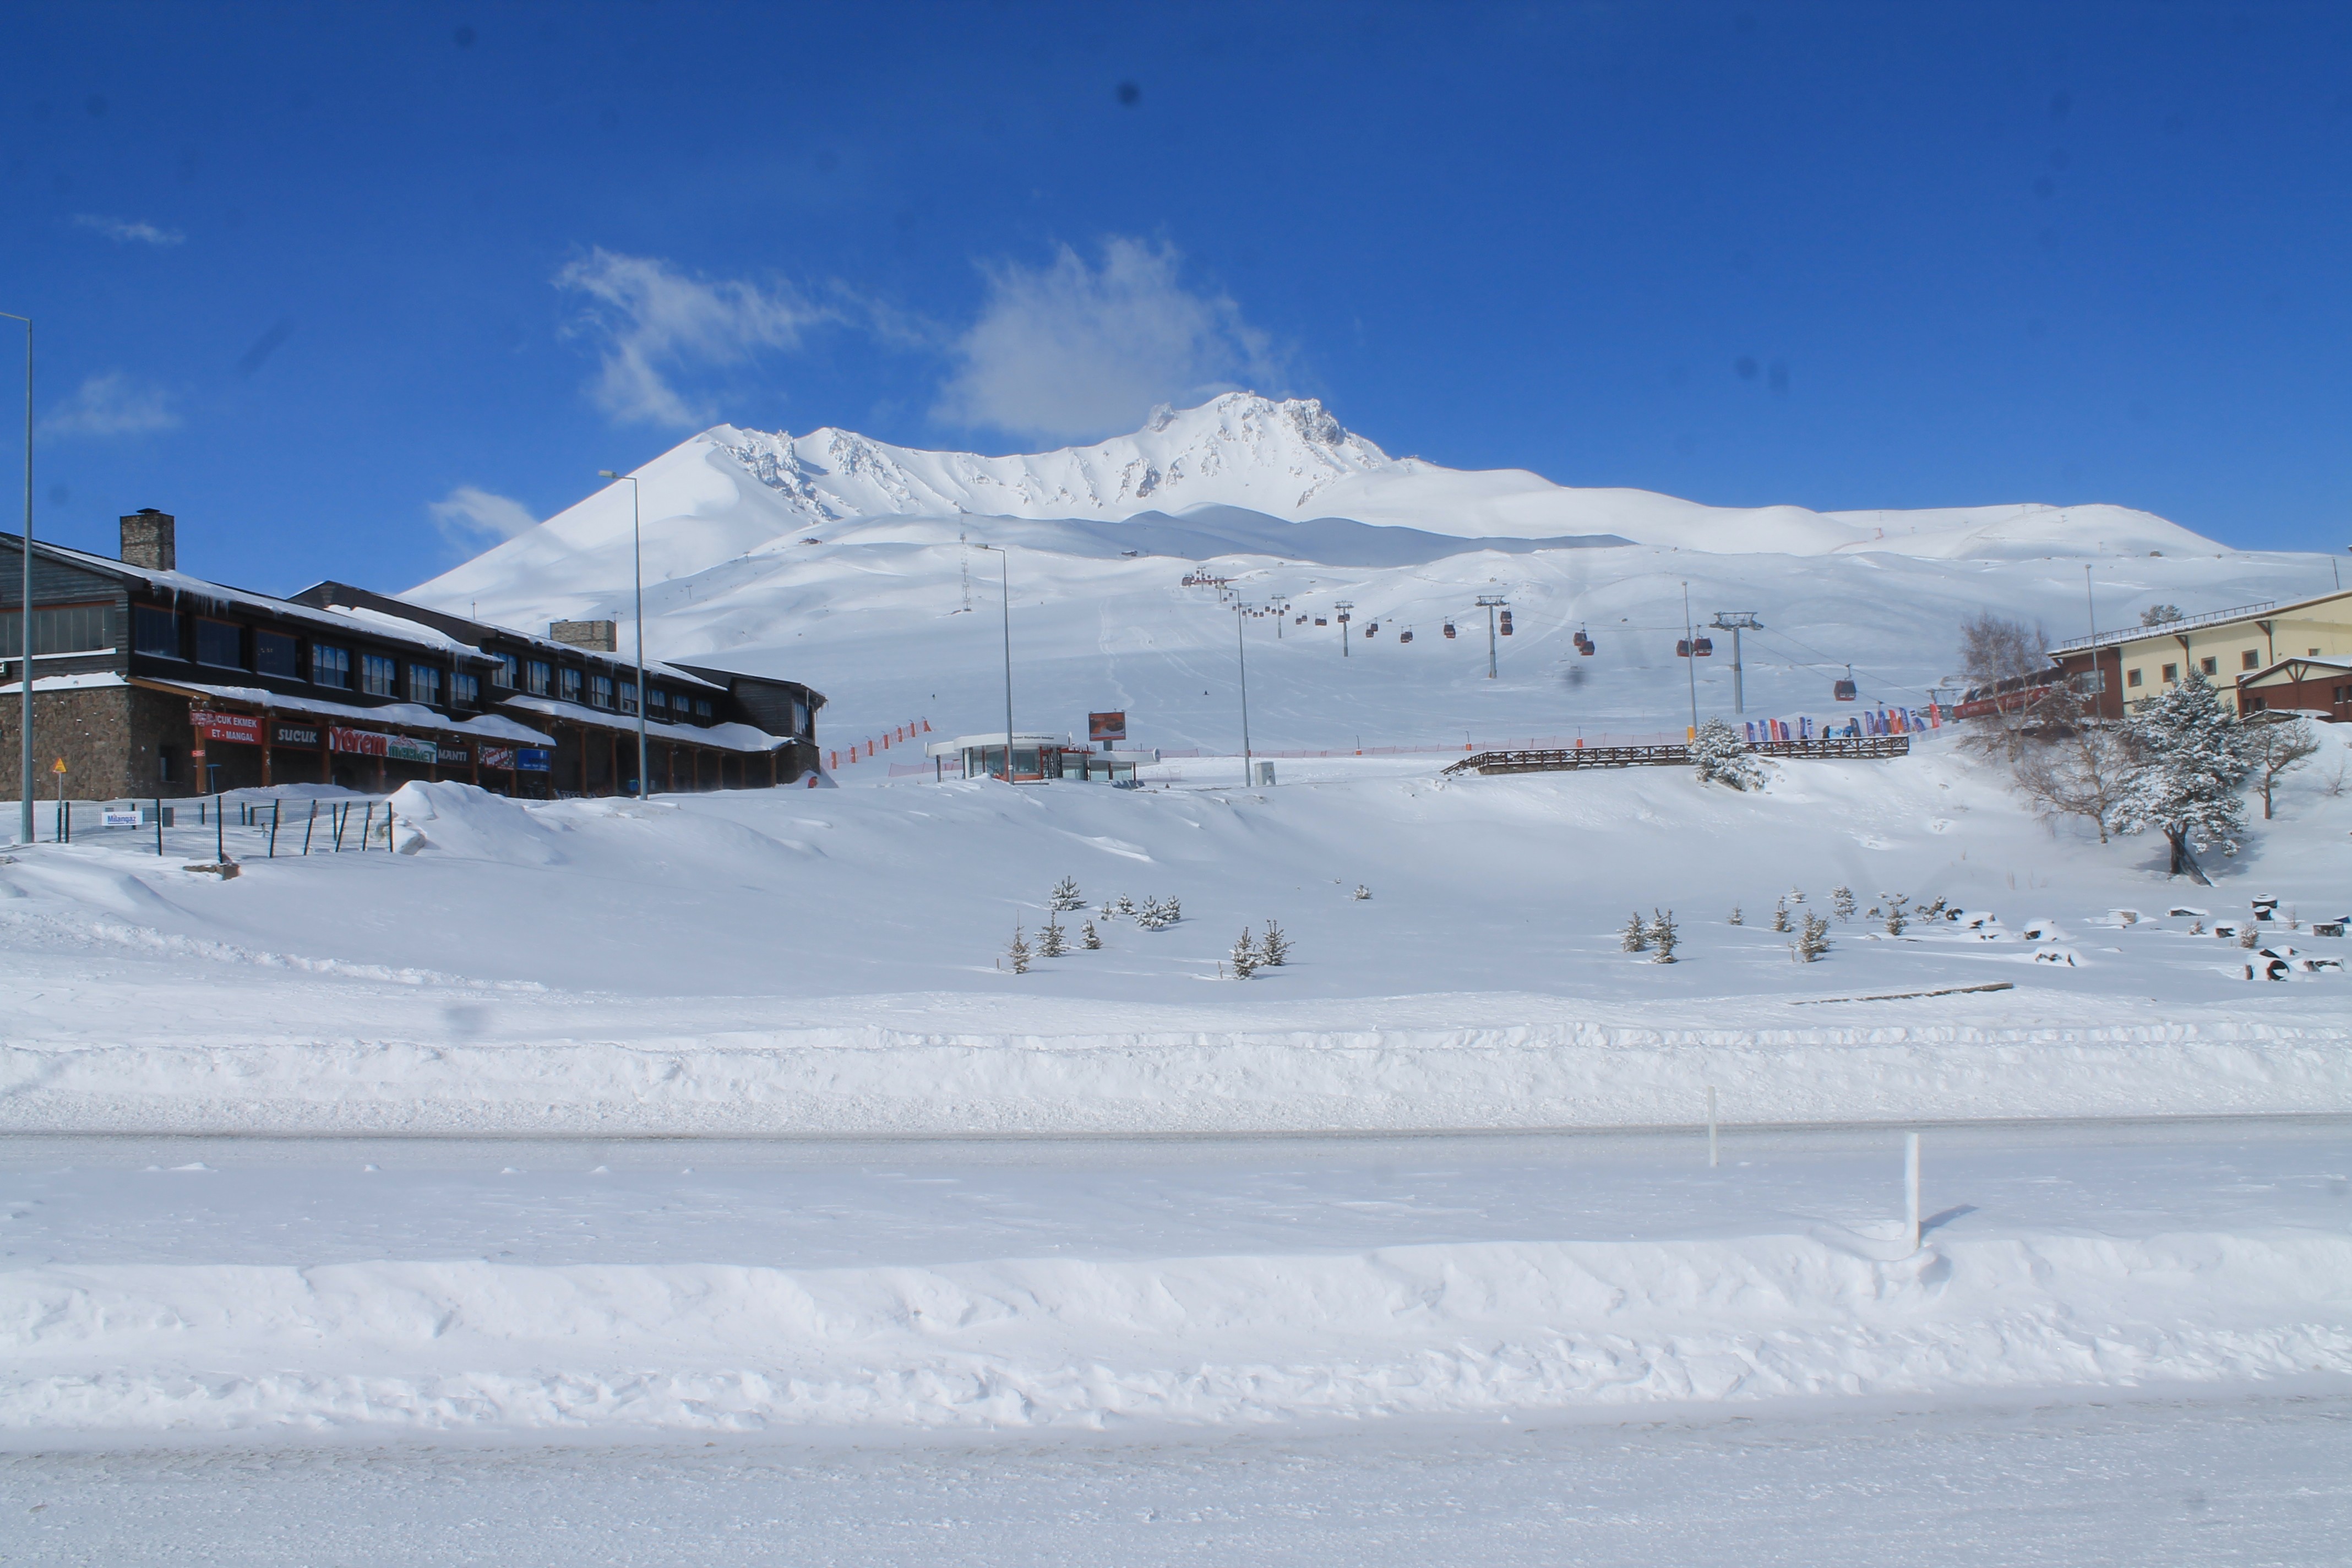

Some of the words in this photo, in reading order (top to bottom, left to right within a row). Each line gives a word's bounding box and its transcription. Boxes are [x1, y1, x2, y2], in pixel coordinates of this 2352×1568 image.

[233, 717, 257, 728] EKMEK
[211, 728, 221, 738] ET
[226, 731, 254, 742] MANGAL
[278, 728, 317, 743] SUCUK
[331, 726, 388, 756] Yörem
[389, 746, 435, 763] MARKET
[438, 749, 467, 761] MANTI
[107, 815, 137, 824] Milangaz
